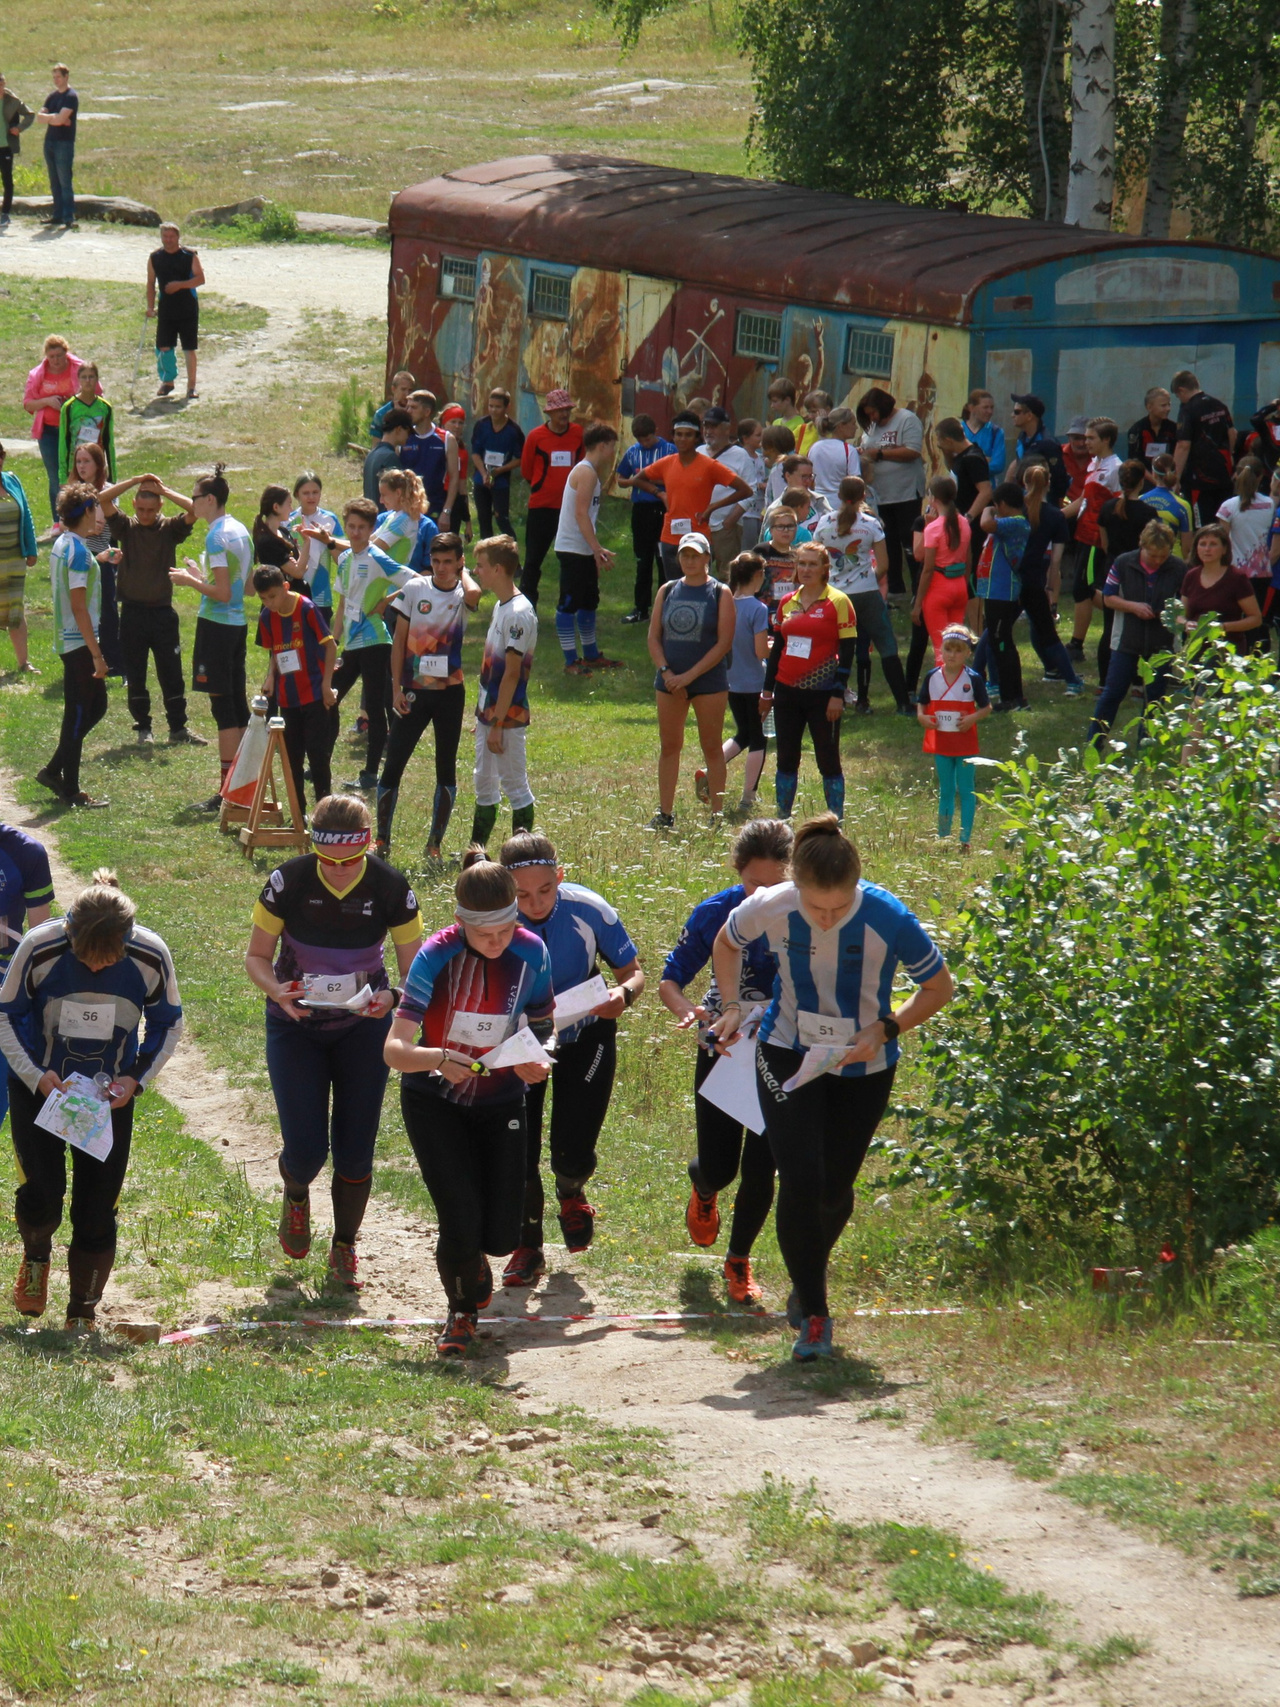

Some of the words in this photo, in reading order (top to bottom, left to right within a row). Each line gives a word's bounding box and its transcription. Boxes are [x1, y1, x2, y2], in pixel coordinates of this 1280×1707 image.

[326, 982, 341, 993] 62
[82, 1011, 98, 1022] 56
[476, 1022, 493, 1032] 53
[819, 1025, 835, 1036] 51
[584, 1043, 605, 1083] noname
